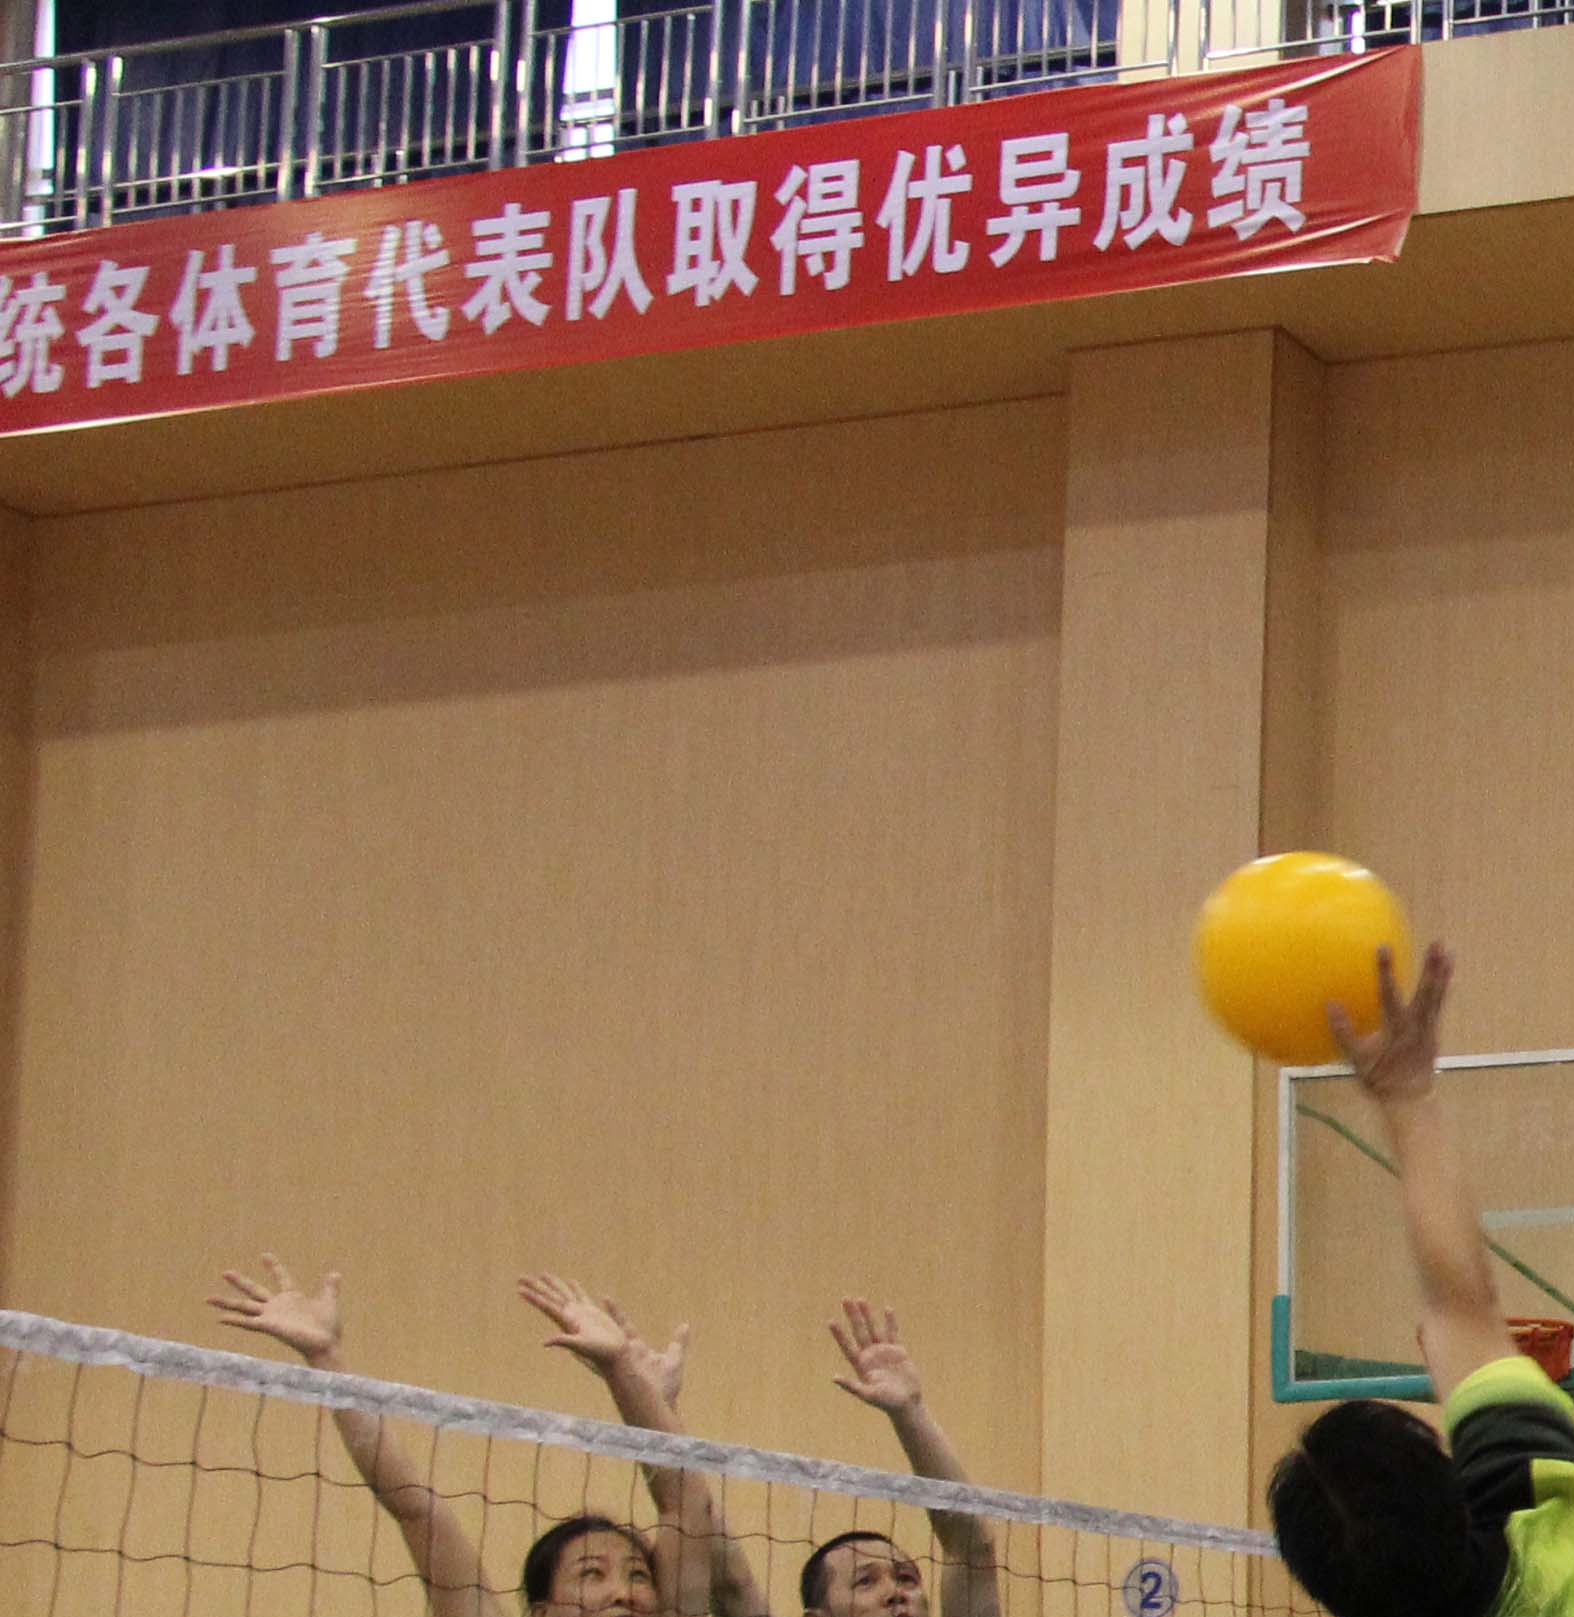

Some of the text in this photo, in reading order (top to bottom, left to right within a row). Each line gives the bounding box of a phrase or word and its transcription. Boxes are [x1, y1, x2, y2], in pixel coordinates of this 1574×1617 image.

[0, 98, 1310, 398] 统各体育代表队取得优异成绩
[1140, 1571, 1162, 1609] 2
